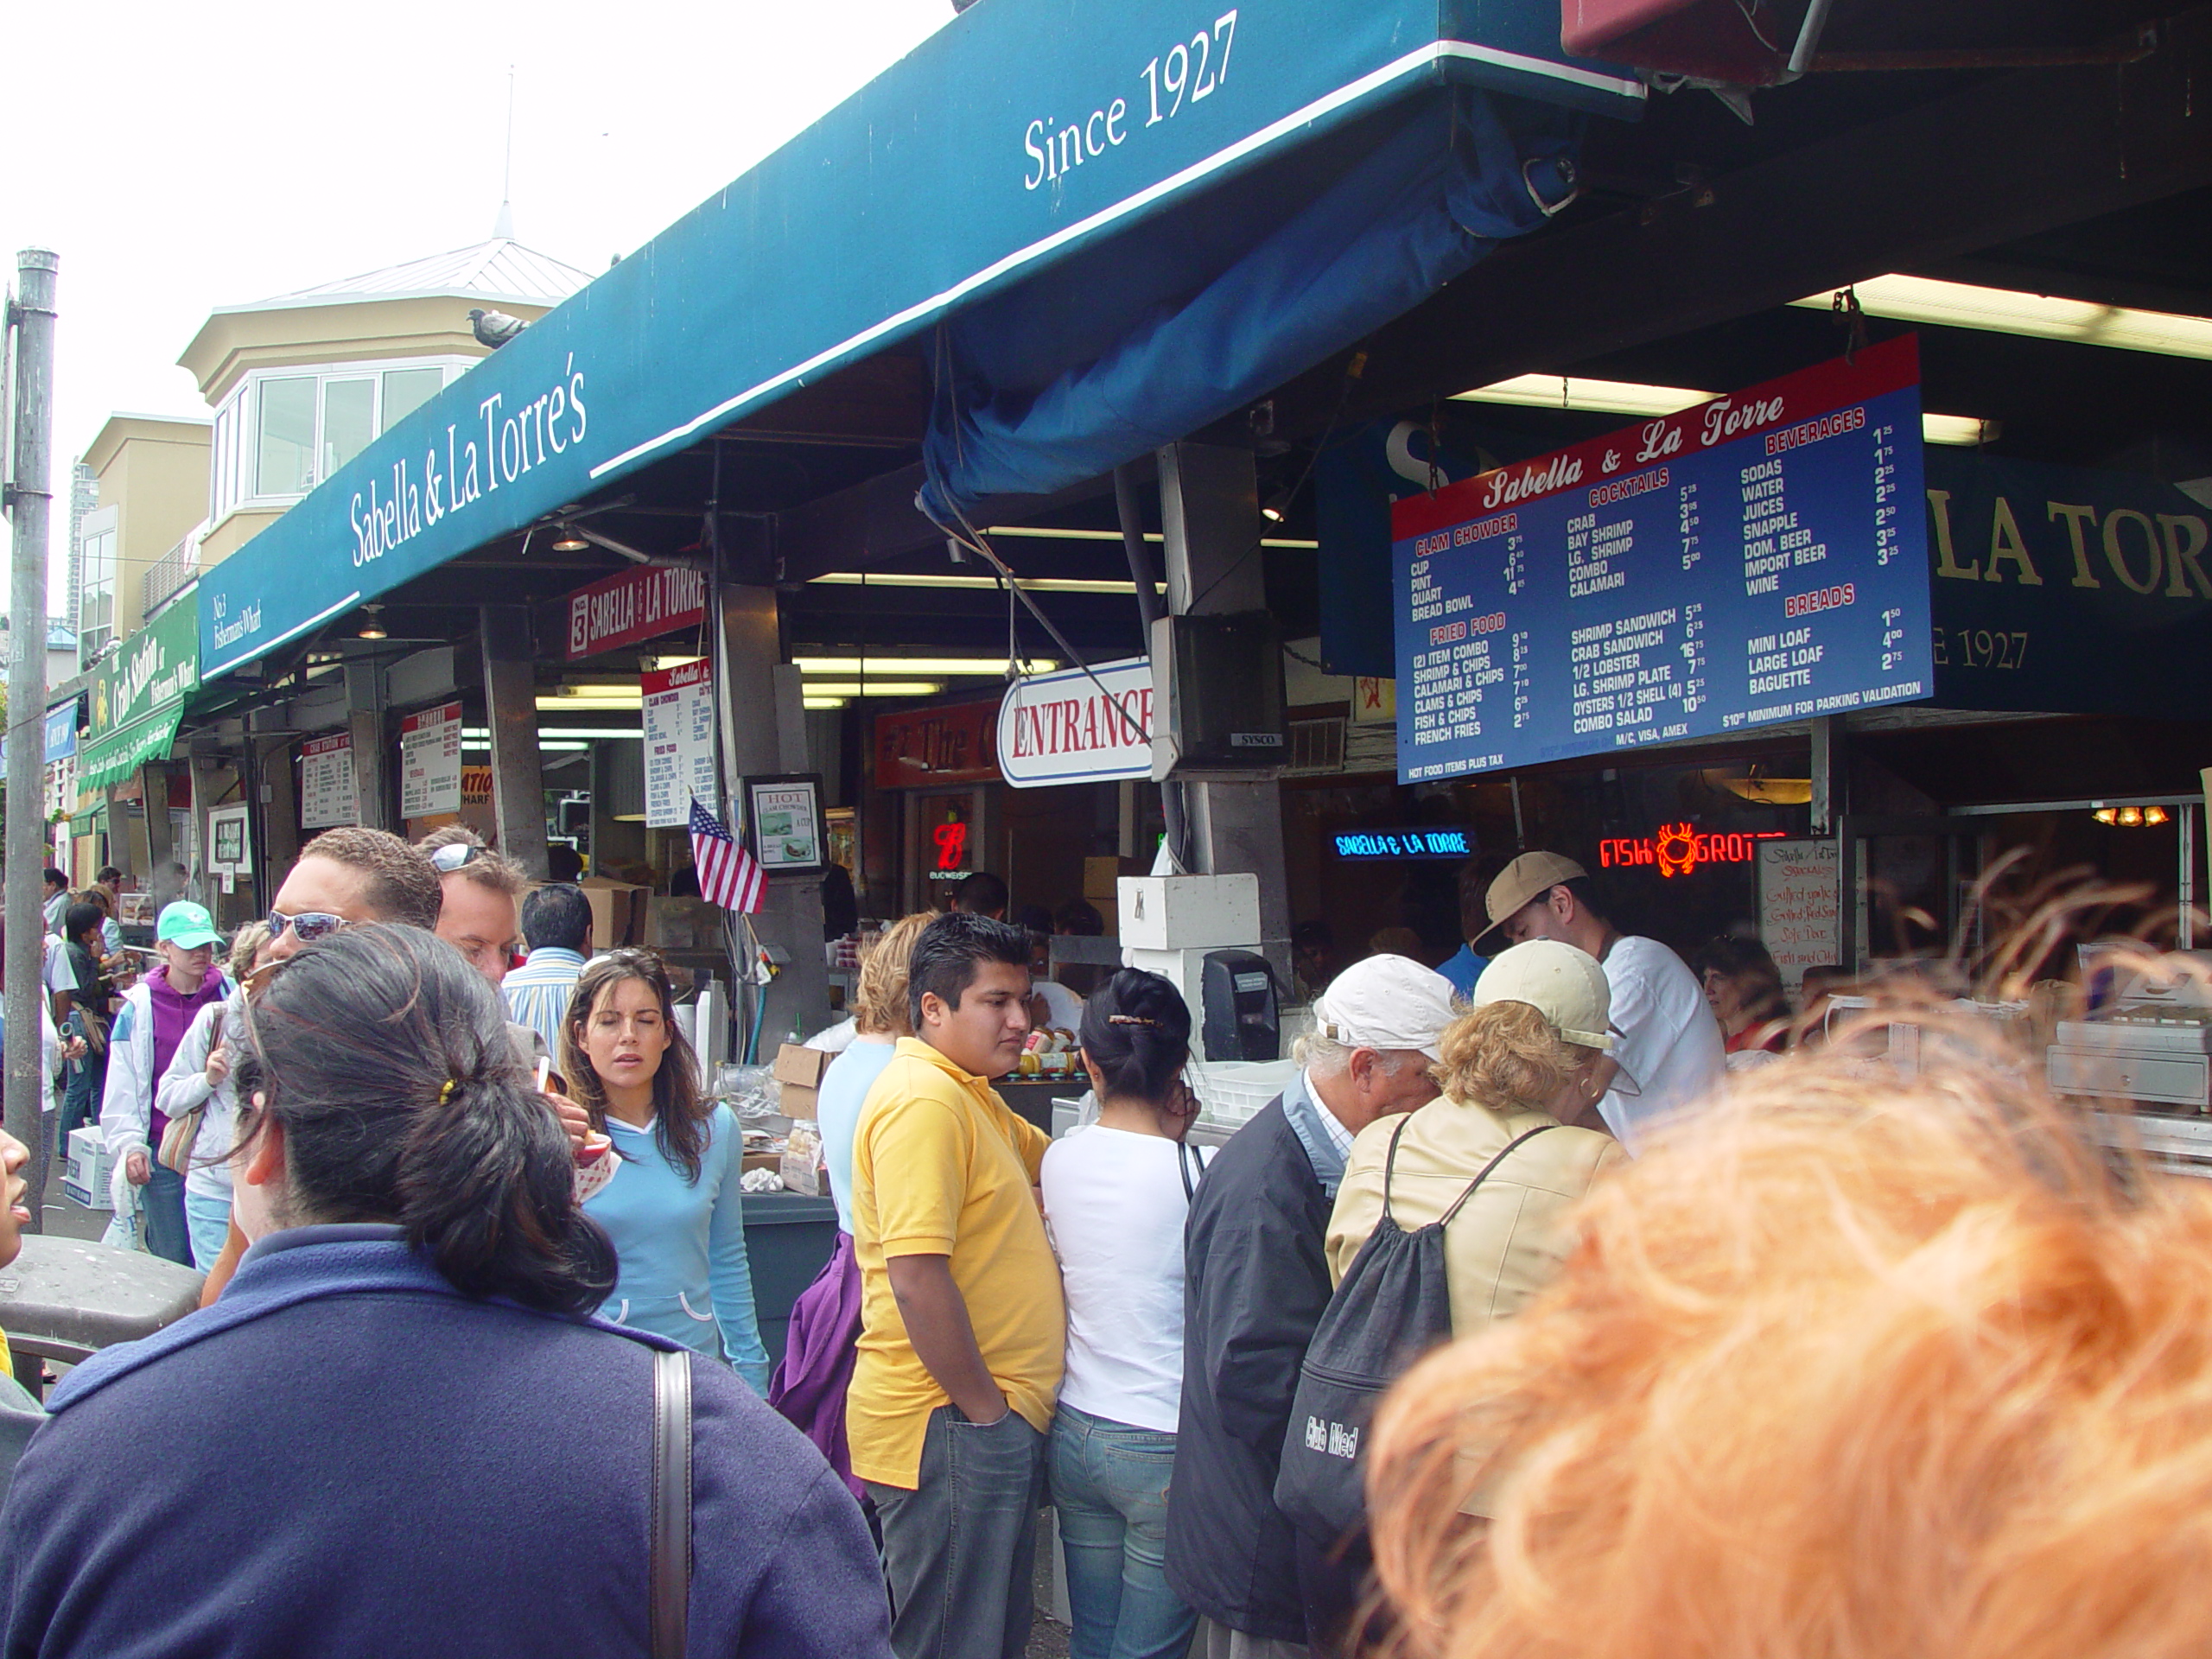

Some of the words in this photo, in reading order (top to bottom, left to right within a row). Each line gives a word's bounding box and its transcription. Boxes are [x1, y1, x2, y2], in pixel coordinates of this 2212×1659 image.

[1025, 99, 1127, 190] Since
[1140, 9, 1237, 128] 1927
[1765, 407, 1865, 456] BEVERAGES
[1484, 454, 1584, 508] Sabella
[1601, 449, 1621, 473] &
[1636, 419, 1682, 463] La
[1700, 397, 1783, 446] Torre
[1741, 459, 1782, 484] SODAS
[1589, 467, 1669, 508] COCKTAILS
[1742, 478, 1783, 503] WATER
[351, 458, 422, 567] Sabella
[425, 449, 445, 526] &
[1743, 497, 1783, 521] JUICES
[1416, 532, 1450, 557] CLAM
[1454, 513, 1518, 546] CHOWDER
[1567, 513, 1595, 533] CRAB
[1567, 532, 1588, 550] BAY
[1592, 519, 1633, 543] SHRIMP
[1744, 512, 1797, 540] SNAPPLE
[1745, 539, 1776, 560] DOM.
[1780, 529, 1811, 550] BEER
[1927, 489, 2043, 585] LA
[1568, 550, 1584, 567] LG.
[1592, 537, 1632, 560] SHRIMP
[1745, 552, 1791, 578] IMPORT
[1795, 544, 1826, 566] BEER
[1411, 560, 1428, 576] CUP
[1569, 560, 1607, 582] COMBO
[1411, 575, 1432, 592] PINT
[1412, 587, 1442, 606] QUART
[1570, 571, 1624, 598] CALAMARI
[1746, 575, 1778, 596] WINE
[590, 583, 634, 640] SABELLA
[646, 574, 660, 623] LA
[1412, 603, 1442, 621] BREAD
[1446, 595, 1473, 613] BOWL
[1785, 583, 1854, 618] BREADS
[575, 614, 585, 645] 3
[1430, 621, 1465, 646] FRIED
[1471, 612, 1505, 636] FOOD
[1572, 623, 1612, 645] SHRIMP
[1616, 607, 1676, 635] SANDWICH
[1428, 649, 1450, 666] ITEM
[1453, 640, 1488, 660] COMBO
[1572, 643, 1599, 663] CRAB
[1604, 629, 1663, 656] SANDWICH
[1748, 635, 1776, 655] MINI
[1780, 628, 1810, 648] LOAF
[1958, 630, 2027, 669] 1927
[1414, 664, 1449, 683] SHRIMP
[1452, 662, 1459, 676] &
[1463, 656, 1491, 673] CHIPS
[1572, 664, 1590, 680] 1/2
[1593, 653, 1640, 677] LOBSTER
[1748, 653, 1788, 675] LARGE
[1792, 645, 1823, 666] LOAF
[1414, 677, 1462, 698] CALAMARI
[1465, 675, 1471, 688] &
[1476, 668, 1503, 686] CHIPS
[1573, 683, 1589, 698] LG.
[1593, 673, 1635, 695] SHRIMP
[1638, 665, 1671, 685] PLATE
[1749, 669, 1810, 695] BAGUETTE
[1414, 695, 1444, 714] CLAMS
[1447, 694, 1453, 708] &
[1457, 689, 1482, 705] CHIPS
[1573, 696, 1614, 716] OYSTERS
[1618, 693, 1633, 709] 1/2
[1637, 686, 1665, 705] SHELL
[1669, 683, 1681, 699] (4)
[1748, 704, 1792, 722] MINIMUM
[1796, 701, 1813, 714] FOR
[1816, 692, 1859, 709] PARKING
[1862, 681, 1921, 703] VALIDATION
[1012, 687, 1153, 758] ENTRANCE
[1415, 715, 1434, 730] FISH
[1438, 712, 1445, 725] &
[1448, 706, 1476, 723] CHIPS
[1573, 714, 1612, 734] COMBO
[1617, 707, 1652, 727] SALAD
[1241, 734, 1274, 745] SYSCO
[1415, 727, 1452, 746] FRENCH
[1454, 721, 1481, 739] FRIES
[1616, 732, 1636, 746] M/C,
[1638, 728, 1660, 742] VISA,
[1662, 722, 1688, 738] AMEX
[1408, 768, 1421, 779] HOT
[1424, 765, 1442, 777] FOOD
[1446, 760, 1466, 773] ITEMS
[1469, 757, 1486, 768] PLUS
[1489, 754, 1503, 766] TAX
[463, 794, 490, 804] HARF
[768, 793, 803, 804] HOT
[1402, 834, 1425, 853] LA
[1600, 838, 1653, 868] FISH
[1694, 832, 1785, 861] GROT
